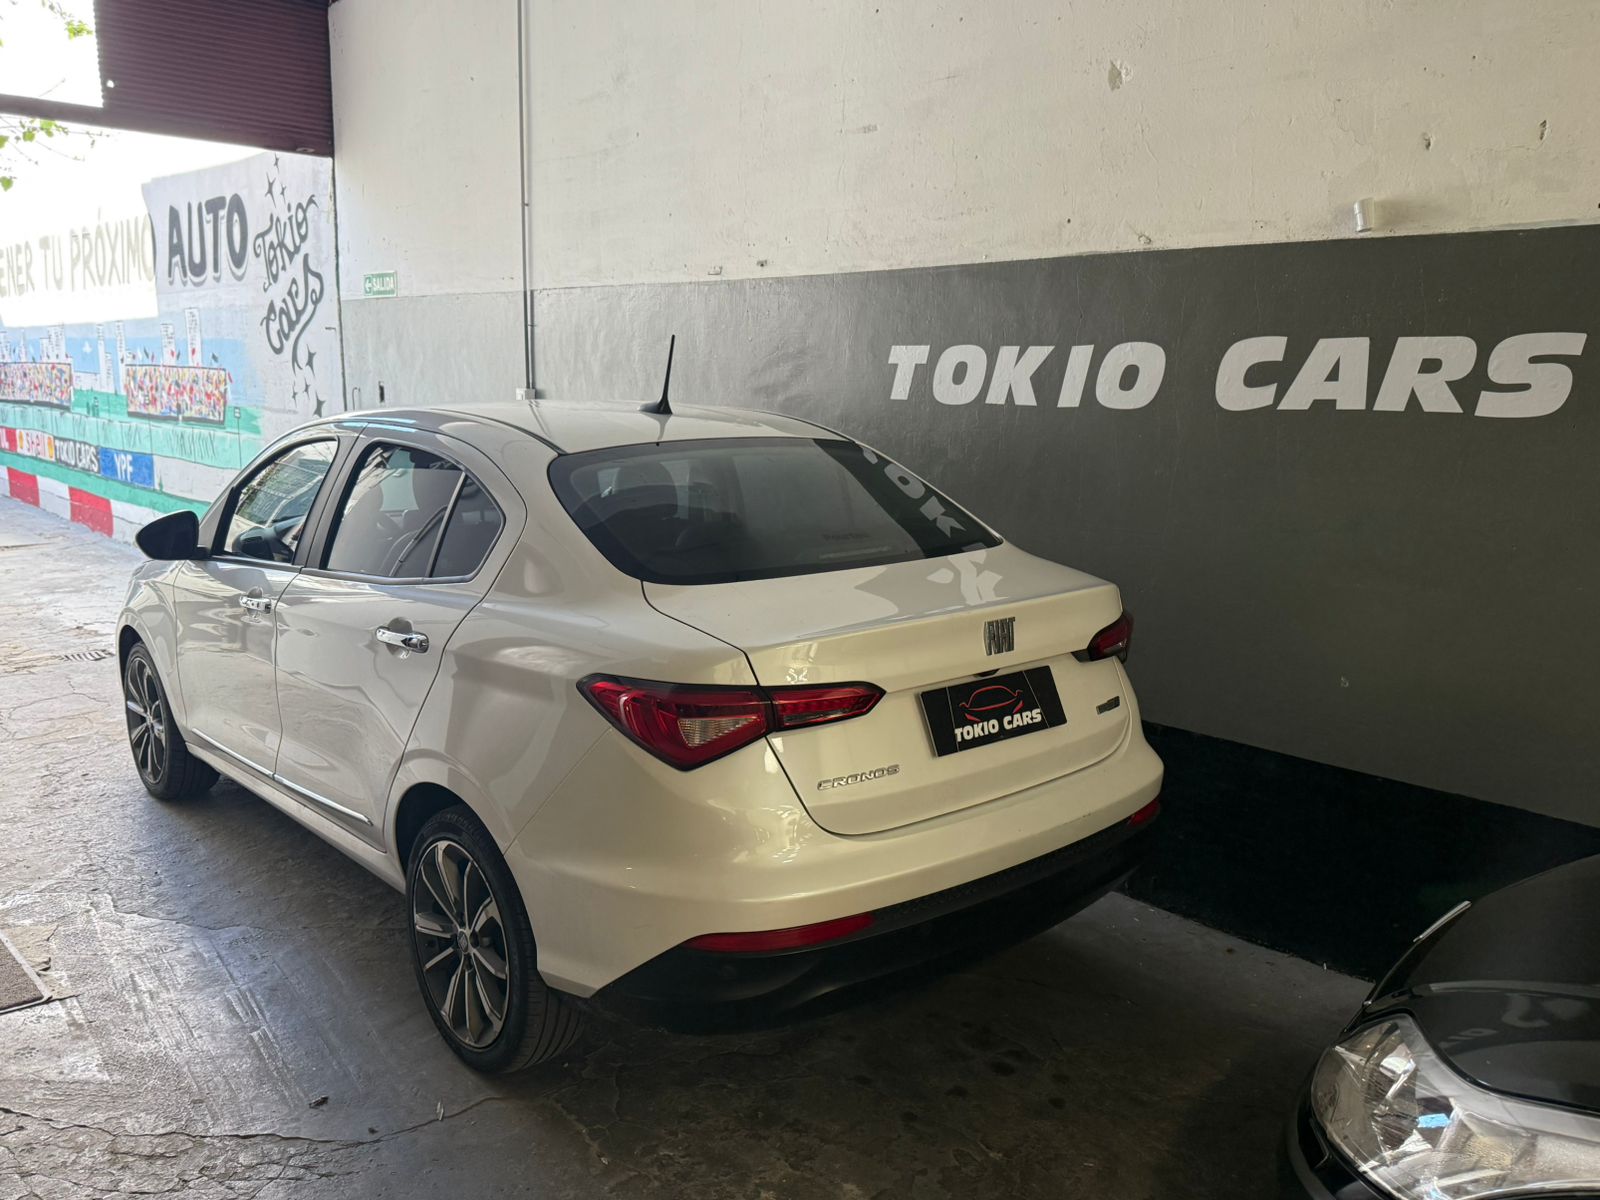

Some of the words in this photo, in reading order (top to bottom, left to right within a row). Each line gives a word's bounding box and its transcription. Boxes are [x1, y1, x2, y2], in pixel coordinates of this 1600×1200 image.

[39, 235, 63, 291] TU
[167, 193, 249, 286] AUTO
[254, 194, 319, 292] Tokio
[260, 252, 325, 370] Cars
[887, 341, 1166, 410] TOKIO
[1215, 332, 1588, 419] CARS
[76, 441, 99, 473] CARS
[113, 453, 134, 482] YPF
[983, 616, 1016, 656] FIAT
[954, 718, 999, 742] TOKIO
[1003, 708, 1042, 730] CARS
[817, 764, 900, 791] CRONOS
